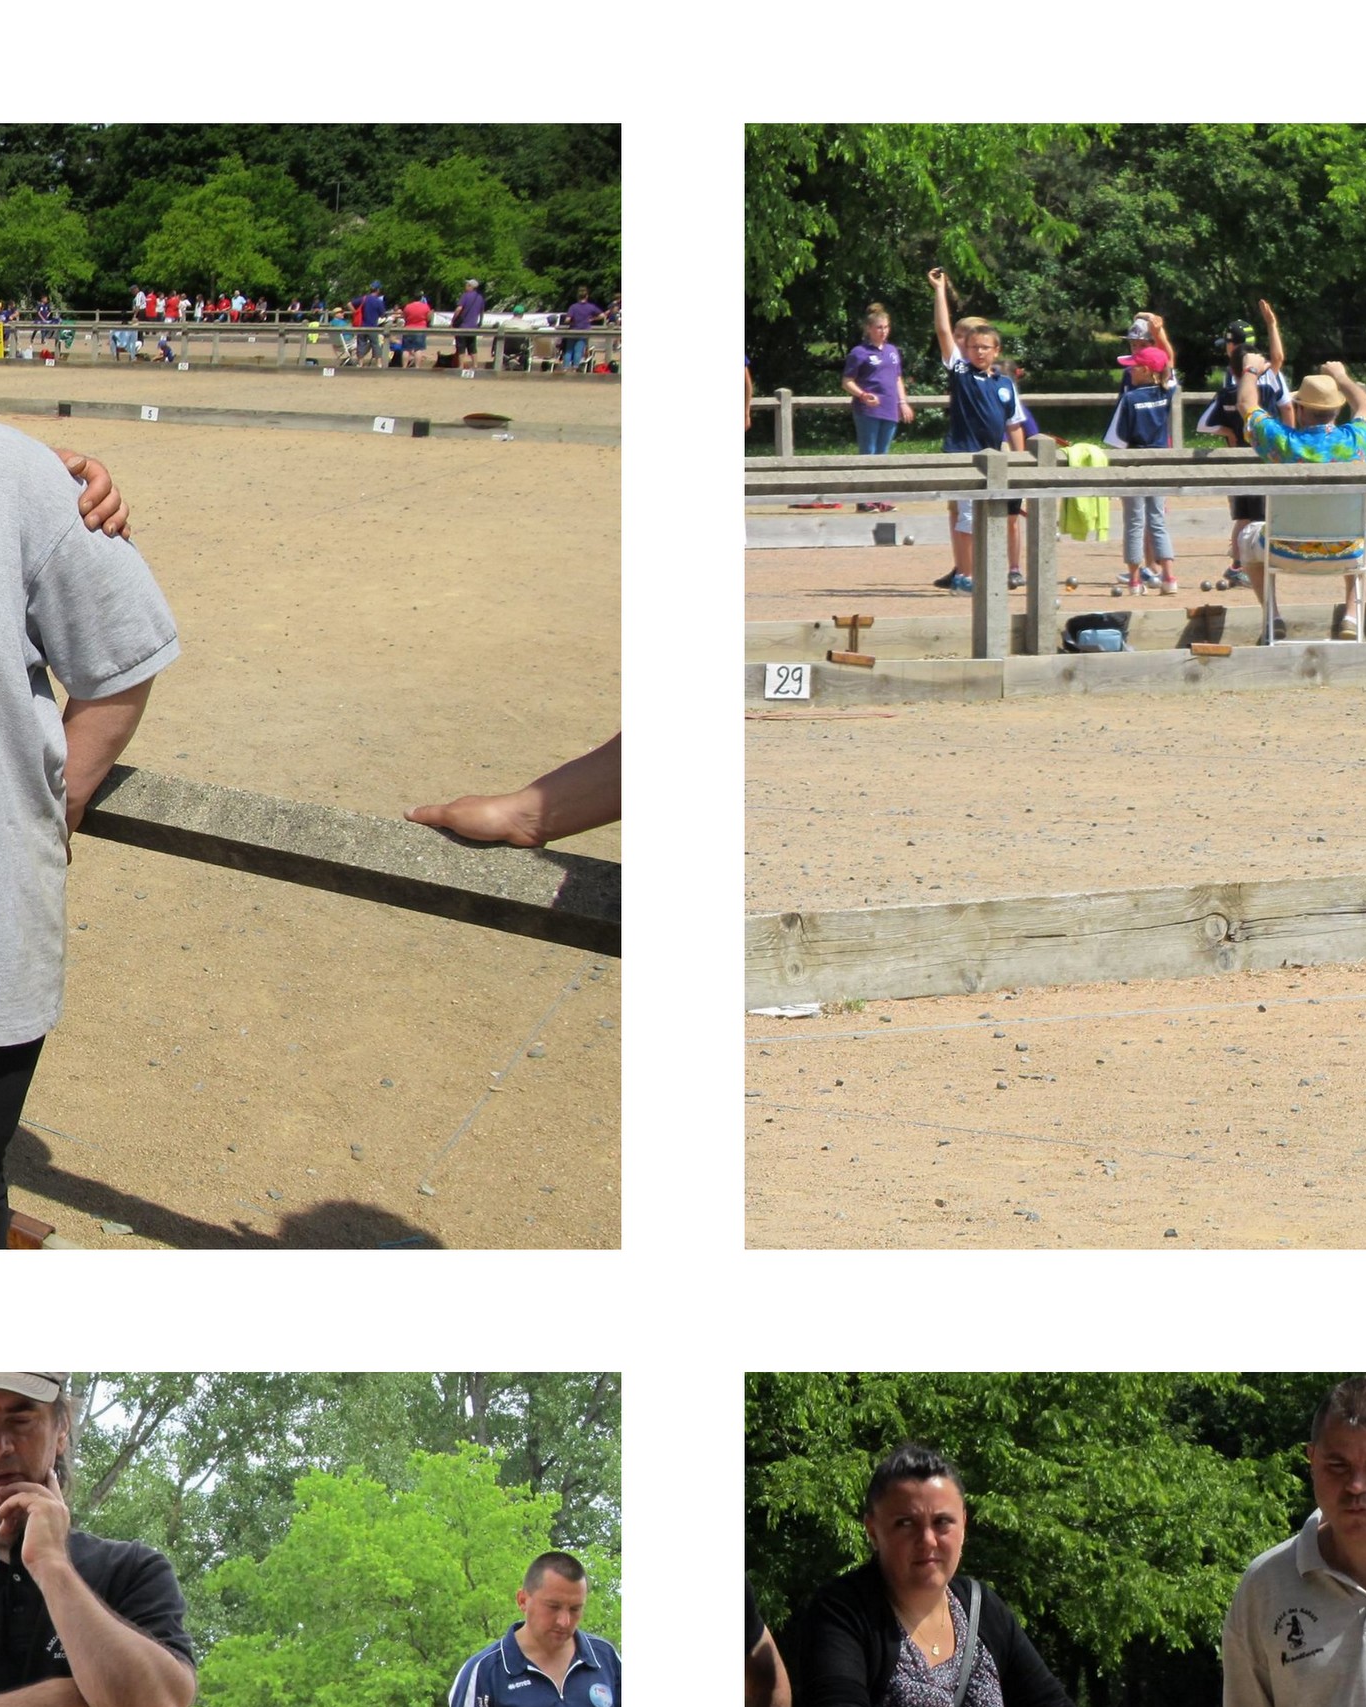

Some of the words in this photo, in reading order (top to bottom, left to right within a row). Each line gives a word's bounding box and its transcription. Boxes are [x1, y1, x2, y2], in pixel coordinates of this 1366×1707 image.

[147, 409, 153, 419] 5
[380, 421, 386, 431] 4
[774, 665, 803, 696] 29
